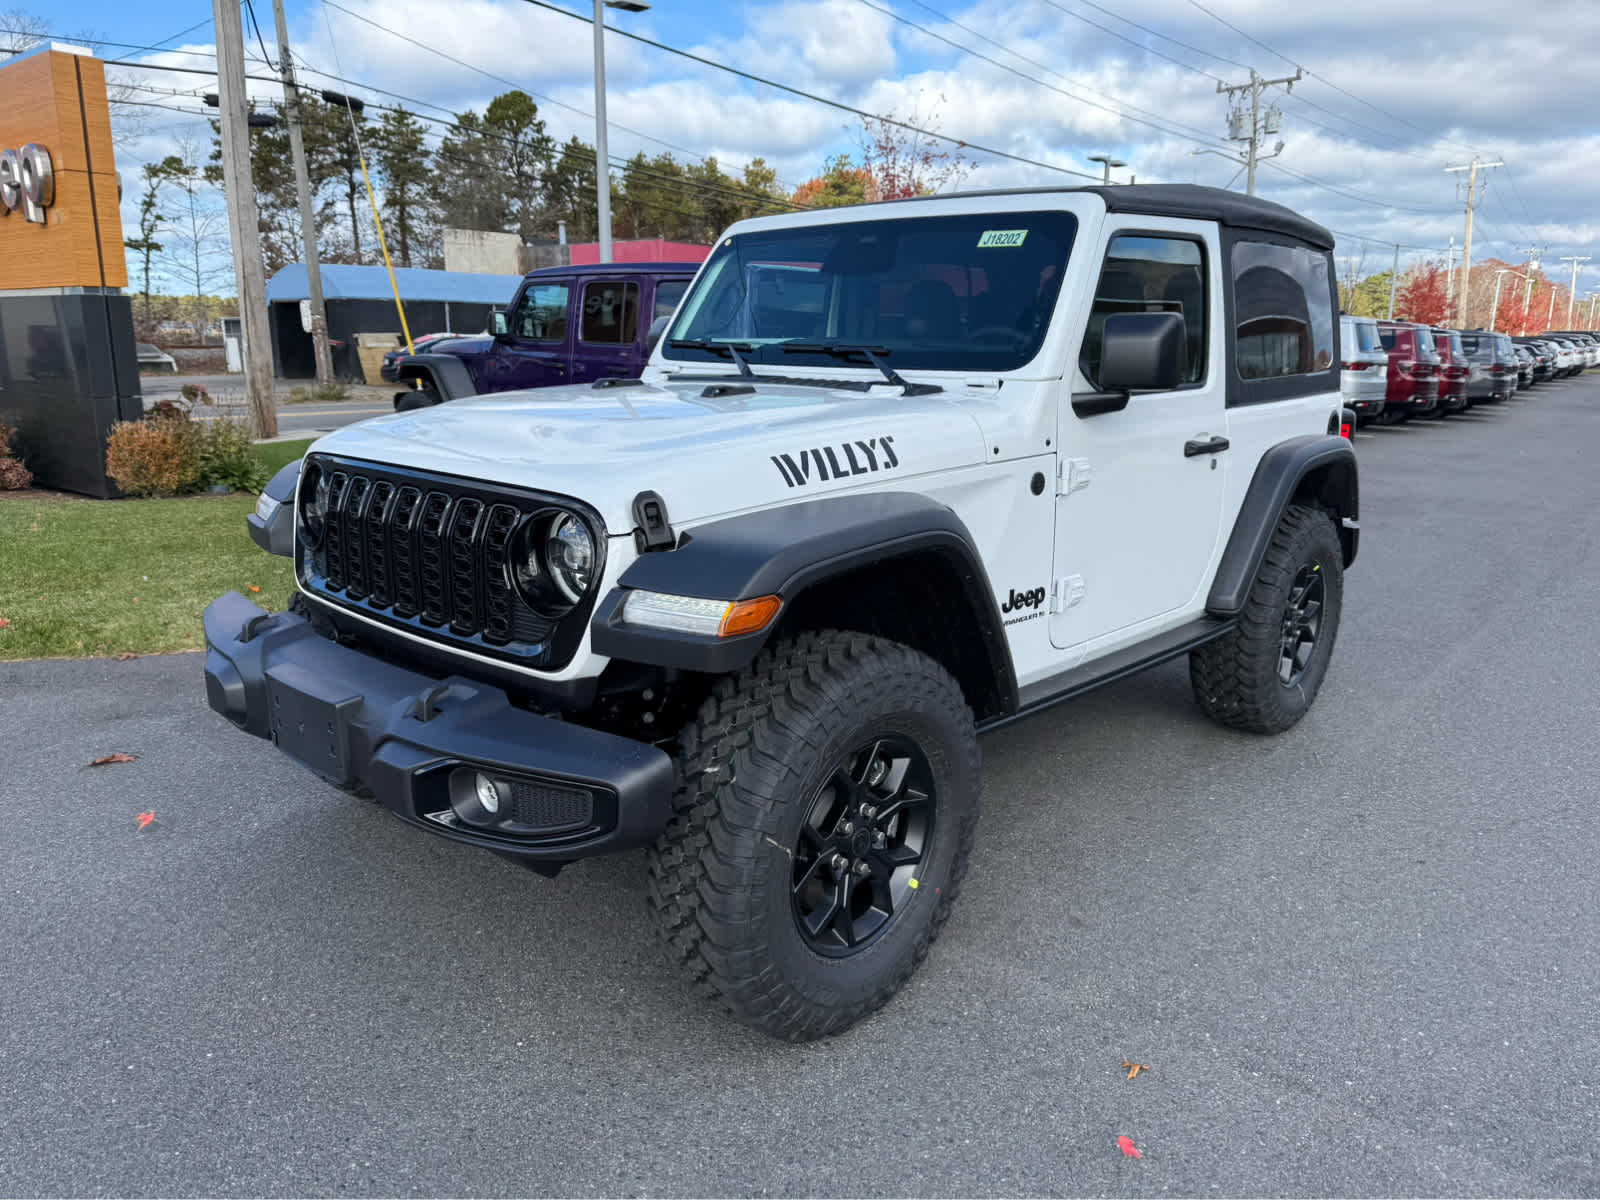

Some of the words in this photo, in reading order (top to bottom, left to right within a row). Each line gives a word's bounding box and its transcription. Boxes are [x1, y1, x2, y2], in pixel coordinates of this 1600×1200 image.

[983, 233, 1021, 245] J18202
[770, 436, 898, 488] WILLYS
[1002, 586, 1045, 613] Jeep
